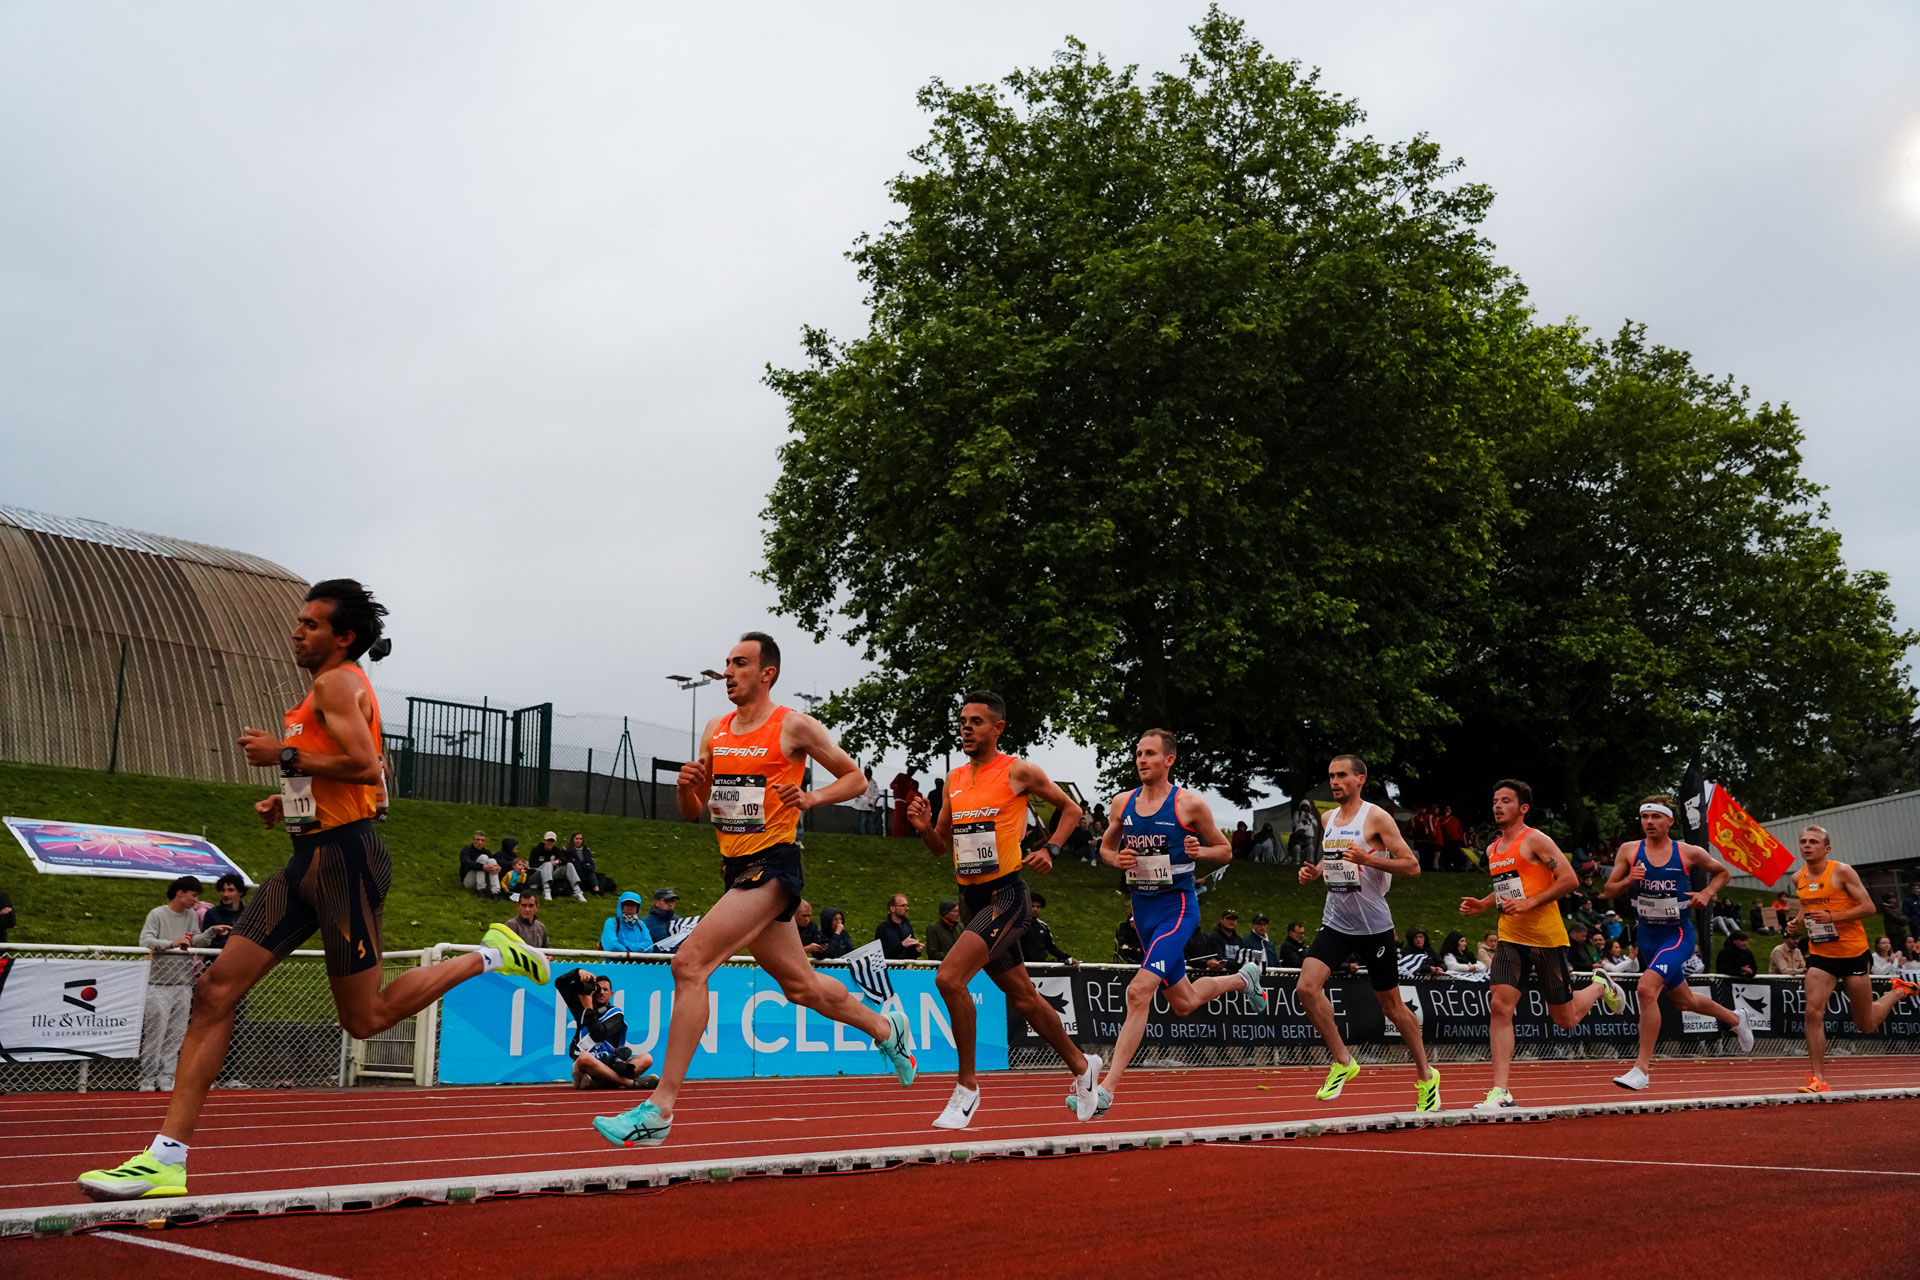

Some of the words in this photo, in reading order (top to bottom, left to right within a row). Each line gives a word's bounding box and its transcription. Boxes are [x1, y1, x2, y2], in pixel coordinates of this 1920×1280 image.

[713, 745, 768, 757] ESPAÑA
[742, 803, 759, 816] 109
[1126, 834, 1167, 848] FRANCE
[977, 846, 993, 860] 106
[1154, 867, 1168, 879] 114
[1343, 870, 1356, 881] 102
[1639, 879, 1677, 891] FRANCE
[1510, 888, 1522, 898] 108
[1207, 987, 1347, 1016] BRETAGE
[1782, 985, 1851, 1015] RÉON
[32, 1014, 56, 1028] Ille
[59, 1012, 73, 1028] &
[76, 1014, 128, 1028] Vilaine
[1170, 1023, 1217, 1039] BREIZH
[1232, 1024, 1276, 1040] REJION
[1594, 1020, 1640, 1037] BERTÈG
